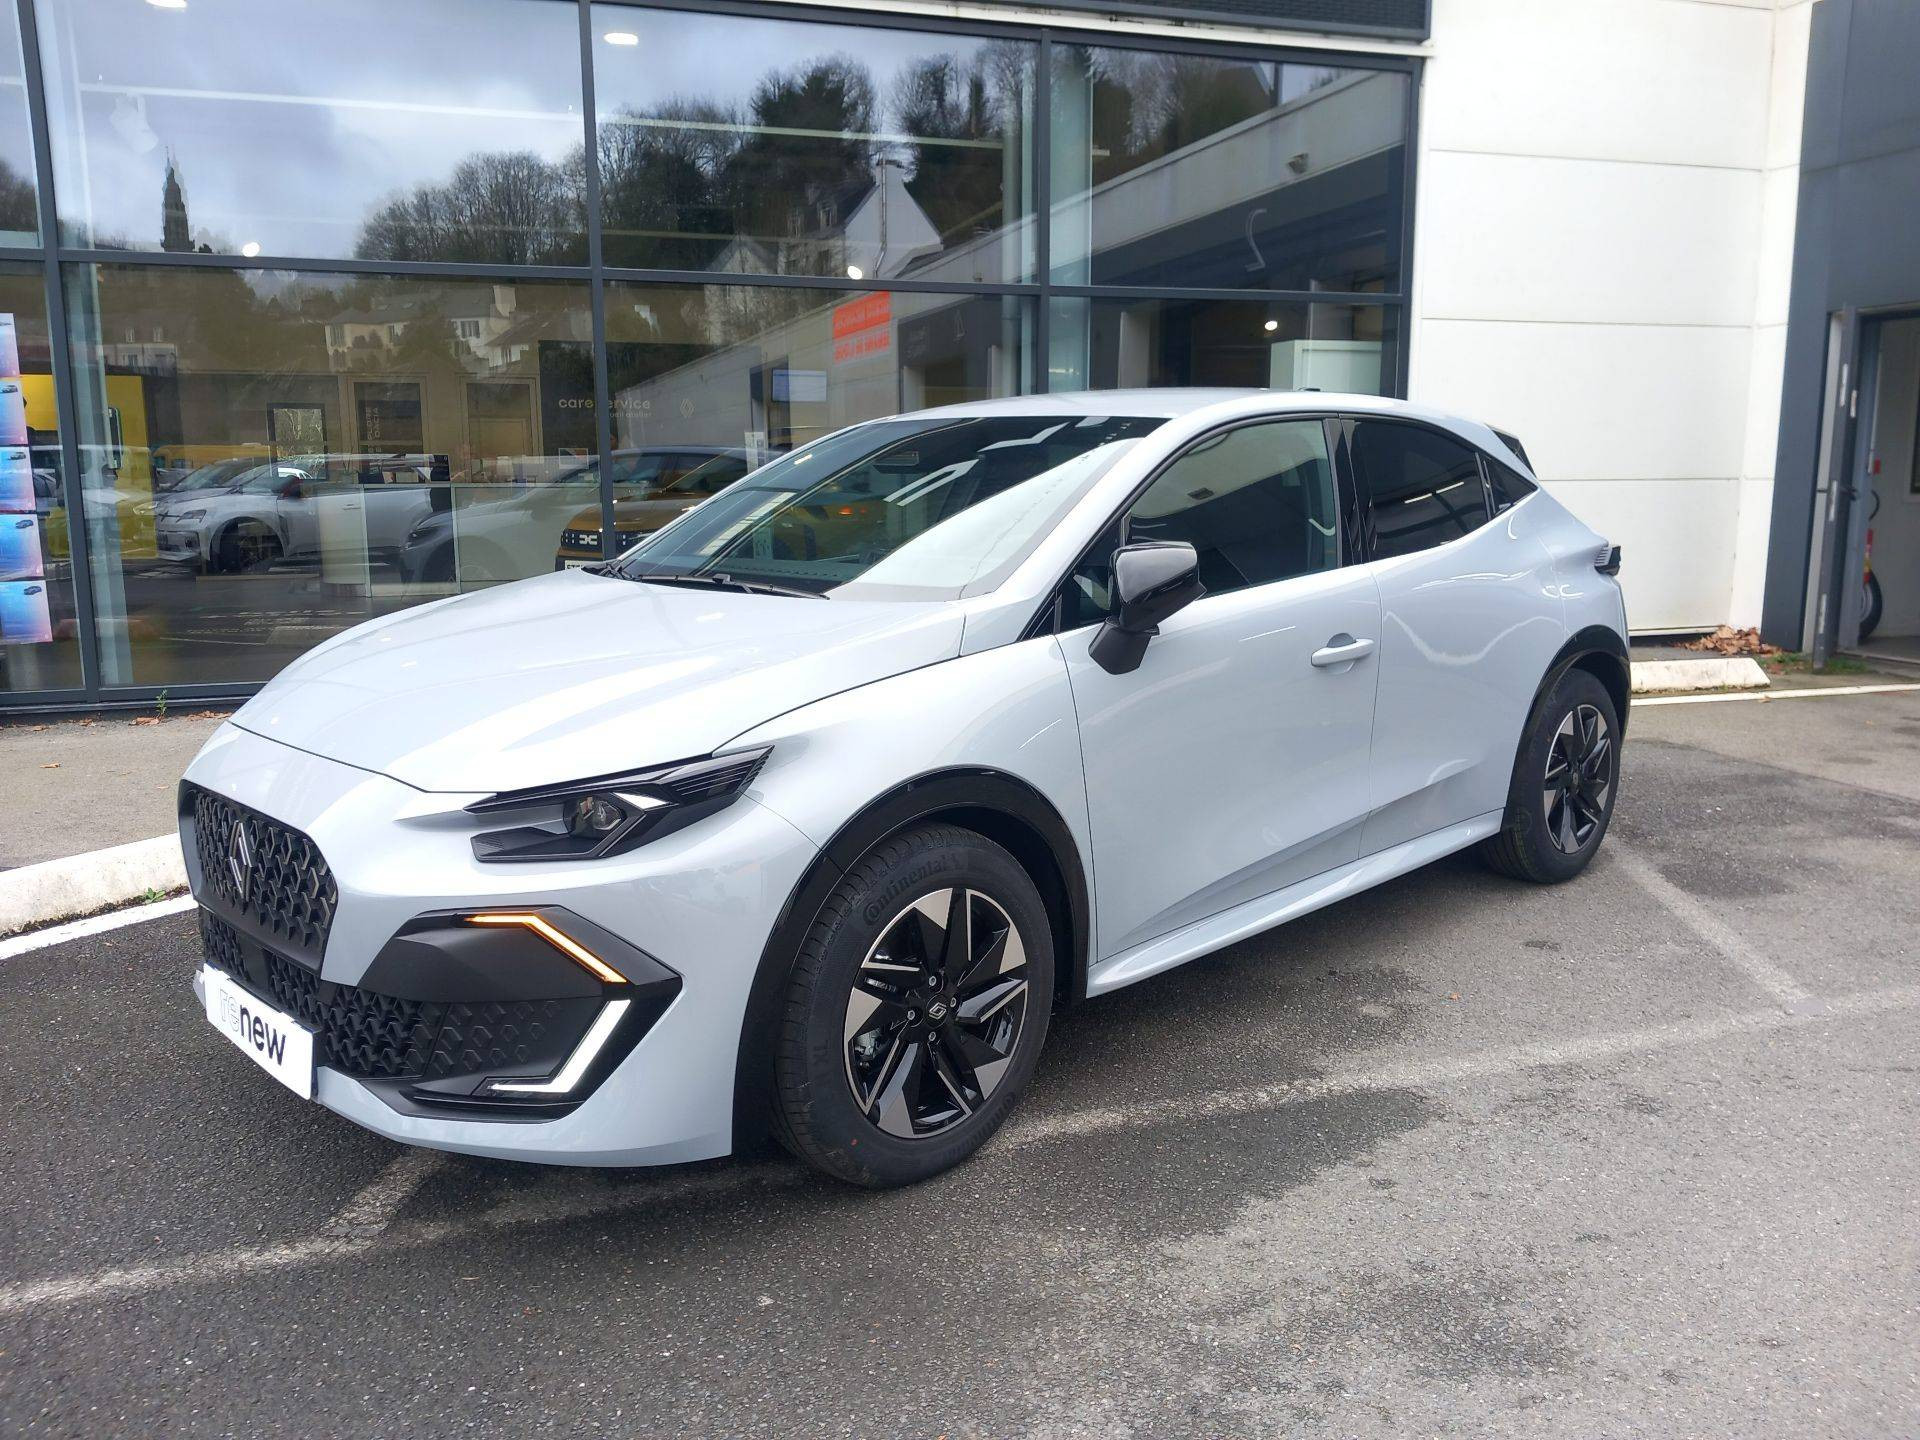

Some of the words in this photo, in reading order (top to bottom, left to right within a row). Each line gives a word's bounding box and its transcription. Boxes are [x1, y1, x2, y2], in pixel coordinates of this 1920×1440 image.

[558, 399, 594, 409] care
[607, 398, 650, 409] ervice
[220, 988, 286, 1066] renew
